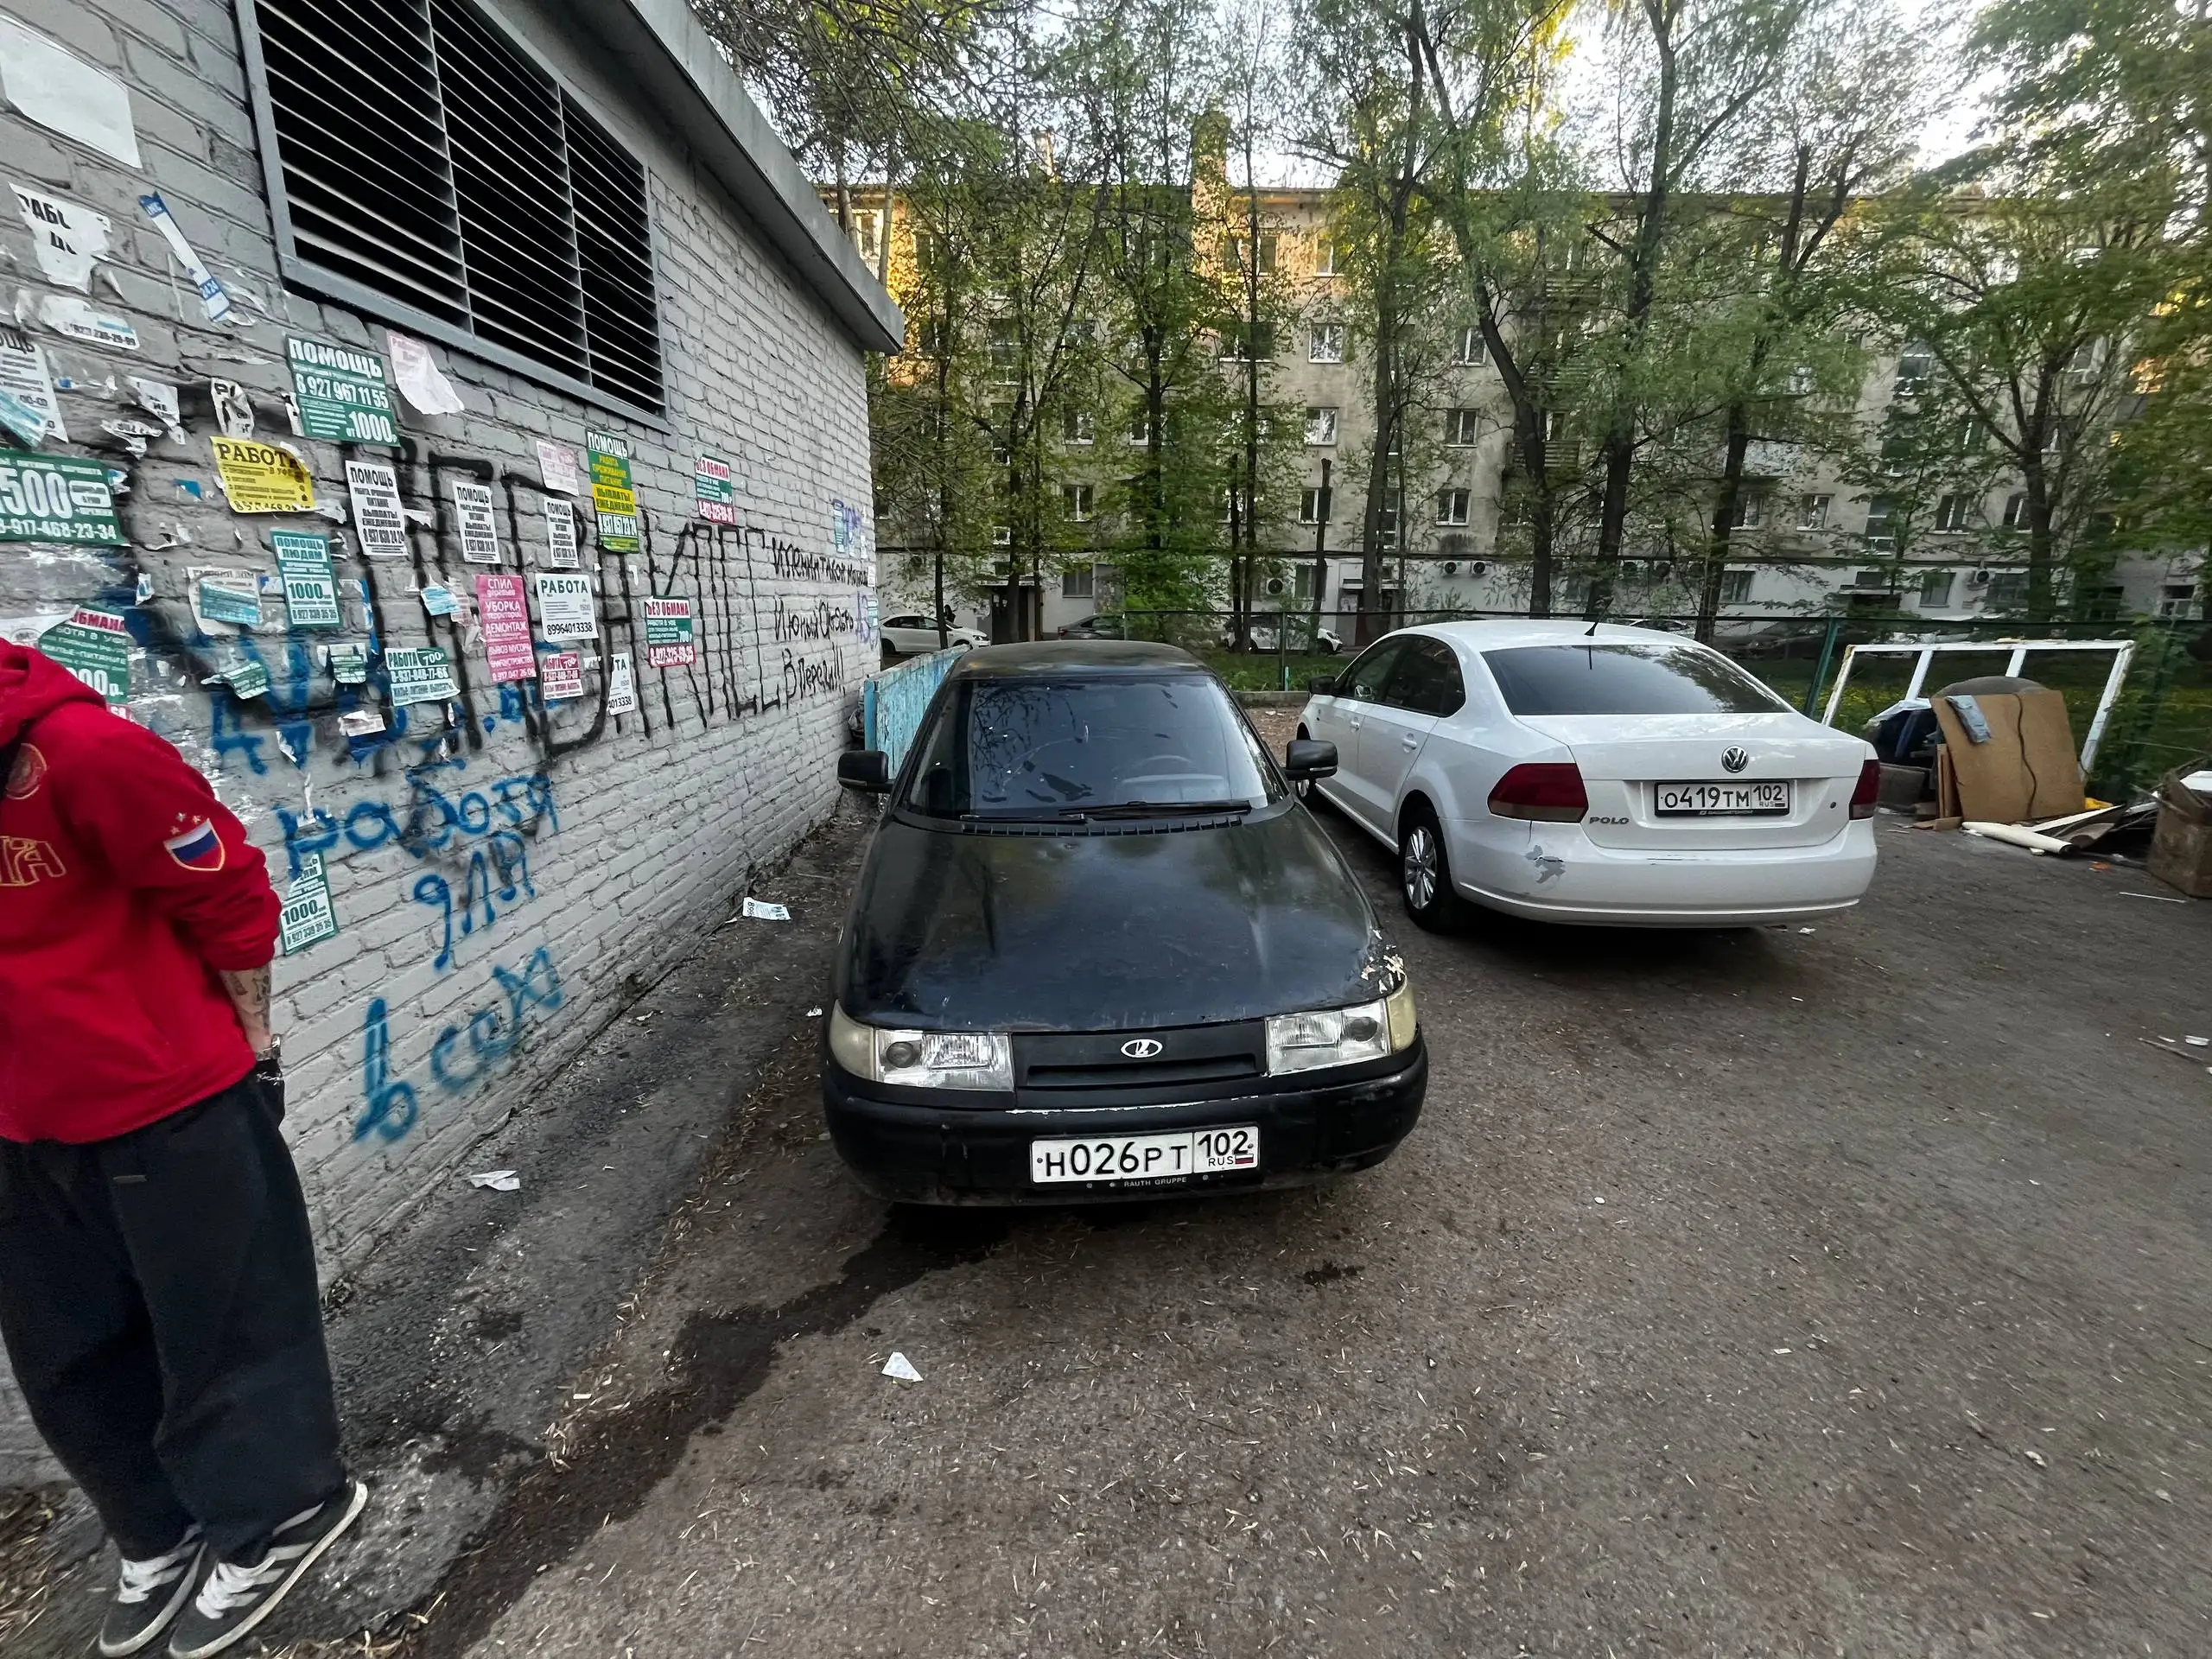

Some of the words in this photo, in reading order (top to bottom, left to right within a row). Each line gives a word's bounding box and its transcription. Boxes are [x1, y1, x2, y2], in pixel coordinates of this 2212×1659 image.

[288, 337, 383, 378] ПОМОЩЬ
[296, 372, 307, 394] 8
[307, 375, 331, 399] 927
[333, 381, 358, 403] 967
[358, 386, 372, 405] 11
[371, 388, 389, 409] 55
[349, 410, 392, 443] 1000
[588, 431, 629, 460] ПОМОЩЬ
[350, 467, 394, 490] ПОМОЩЬ
[456, 486, 491, 506] ПОМОЩЬ
[276, 537, 323, 550] ПОМОЩЬ
[283, 548, 323, 561] ЛЮДЯМ
[288, 582, 323, 600] 1000
[487, 578, 513, 590] СПИЛ
[540, 579, 588, 594] РАБОТА
[485, 600, 522, 613] УБОРКА
[662, 601, 690, 616] ОБМАНА
[486, 621, 528, 637] ДЕМОНТАЖ
[547, 621, 593, 636] 89964013338
[388, 652, 418, 668] РАБОТА
[423, 652, 442, 666] 700
[613, 659, 627, 672] ТА
[1753, 785, 1783, 802] 102
[1588, 817, 1630, 825] POLO
[283, 899, 318, 925] 1000
[1198, 1130, 1249, 1159] 102
[1208, 1155, 1234, 1166] RUS
[1123, 1178, 1151, 1188] RAUTH
[1154, 1176, 1187, 1185] GRUPPE
